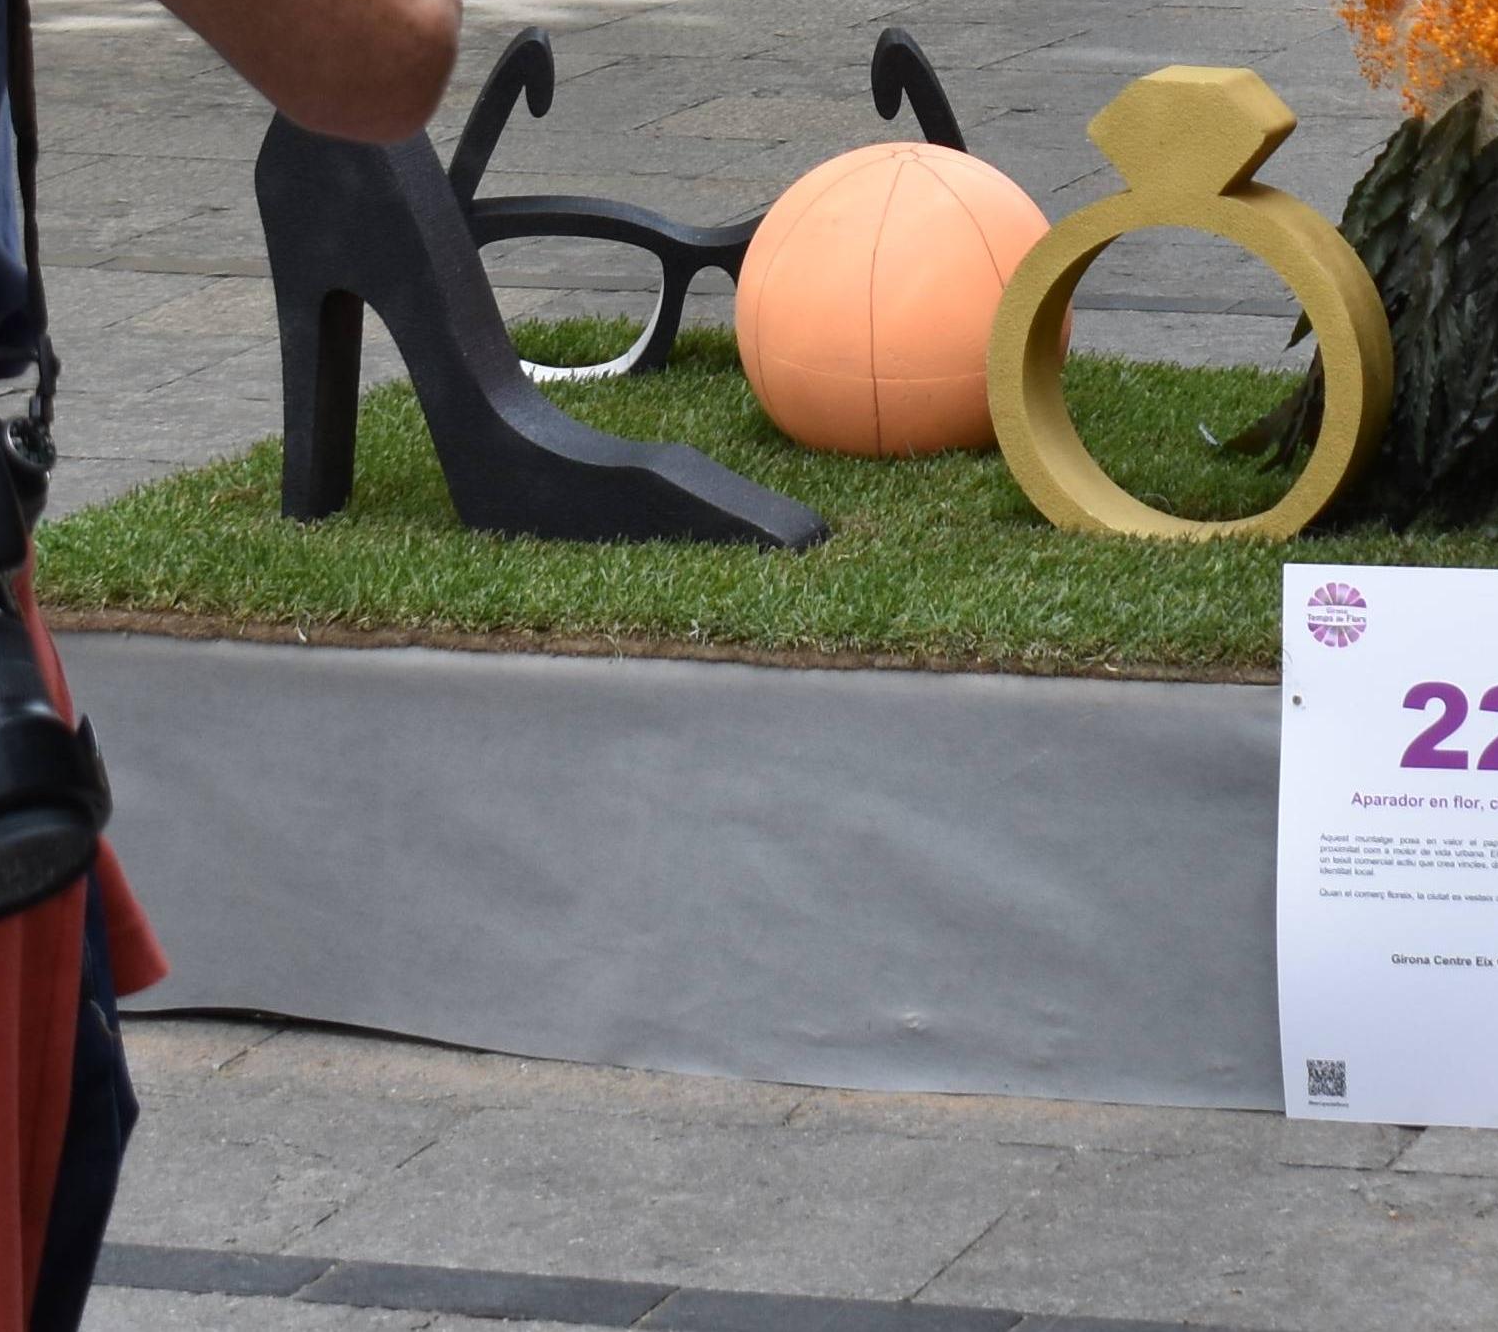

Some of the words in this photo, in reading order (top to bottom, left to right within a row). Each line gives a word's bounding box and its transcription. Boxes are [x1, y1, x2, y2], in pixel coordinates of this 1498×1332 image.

[1351, 792, 1425, 809] Aparador
[1429, 796, 1448, 809] en
[1453, 795, 1485, 812] flor,
[1391, 954, 1430, 966] Girona
[1434, 955, 1472, 967] Centre
[1476, 956, 1494, 968] Eix
